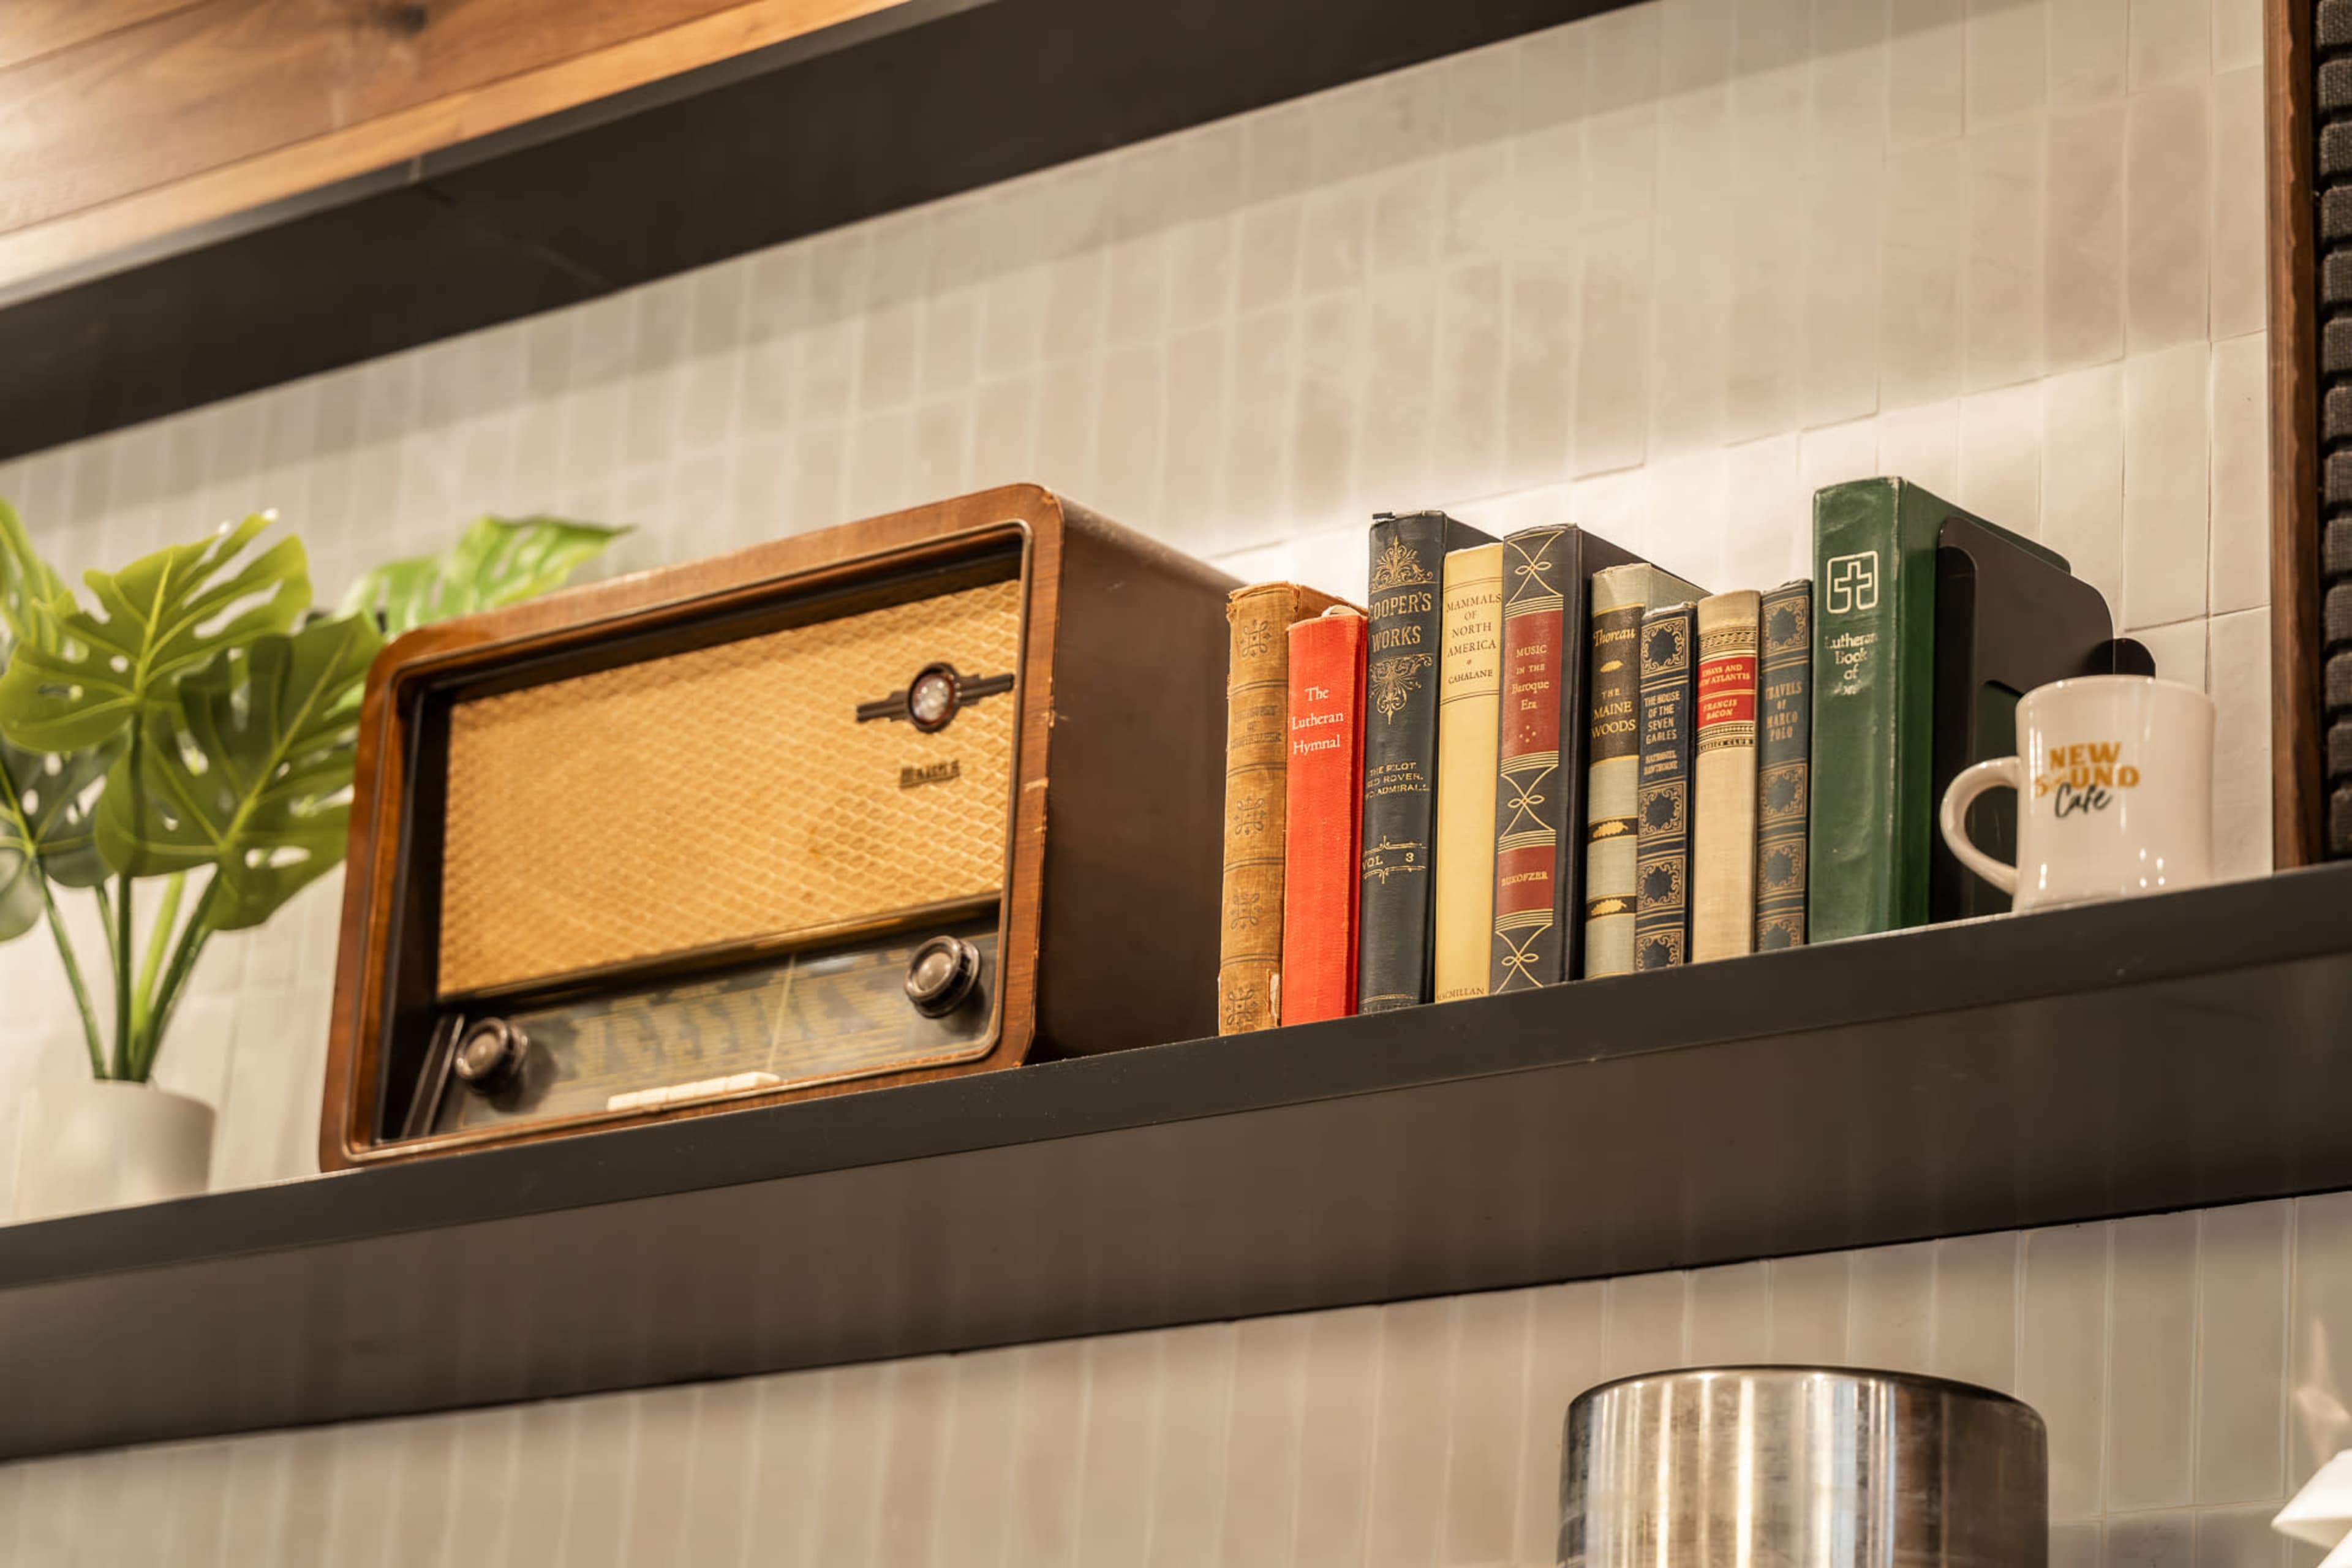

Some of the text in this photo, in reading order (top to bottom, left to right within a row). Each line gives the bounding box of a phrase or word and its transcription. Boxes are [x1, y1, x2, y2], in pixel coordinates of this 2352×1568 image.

[1369, 591, 1431, 623] COOPER'S
[1447, 593, 1501, 612] MAMMALS
[1464, 612, 1477, 620] OF
[1371, 625, 1422, 652] WORKS
[1452, 622, 1491, 638] NORTH
[1593, 628, 1635, 647] Thoreau
[1447, 639, 1496, 657] AMERICA
[1825, 632, 1877, 649] Lutheran
[1516, 644, 1548, 657] MUSIC
[1448, 669, 1493, 684] CAHALANE
[1516, 663, 1545, 675] IN THE
[1843, 663, 1859, 680] of
[1305, 687, 1330, 702] The
[1511, 681, 1550, 694] Baroque
[1521, 699, 1537, 710] Era
[1594, 701, 1632, 720] MAINE
[1648, 704, 1675, 718] OF THE
[1291, 711, 1344, 731] Lutheran
[1591, 719, 1637, 738] WOODS
[1648, 716, 1675, 732] SEVEN
[1292, 735, 1341, 756] Hymnal
[2049, 741, 2121, 769] NEW
[1406, 851, 1414, 863] 3
